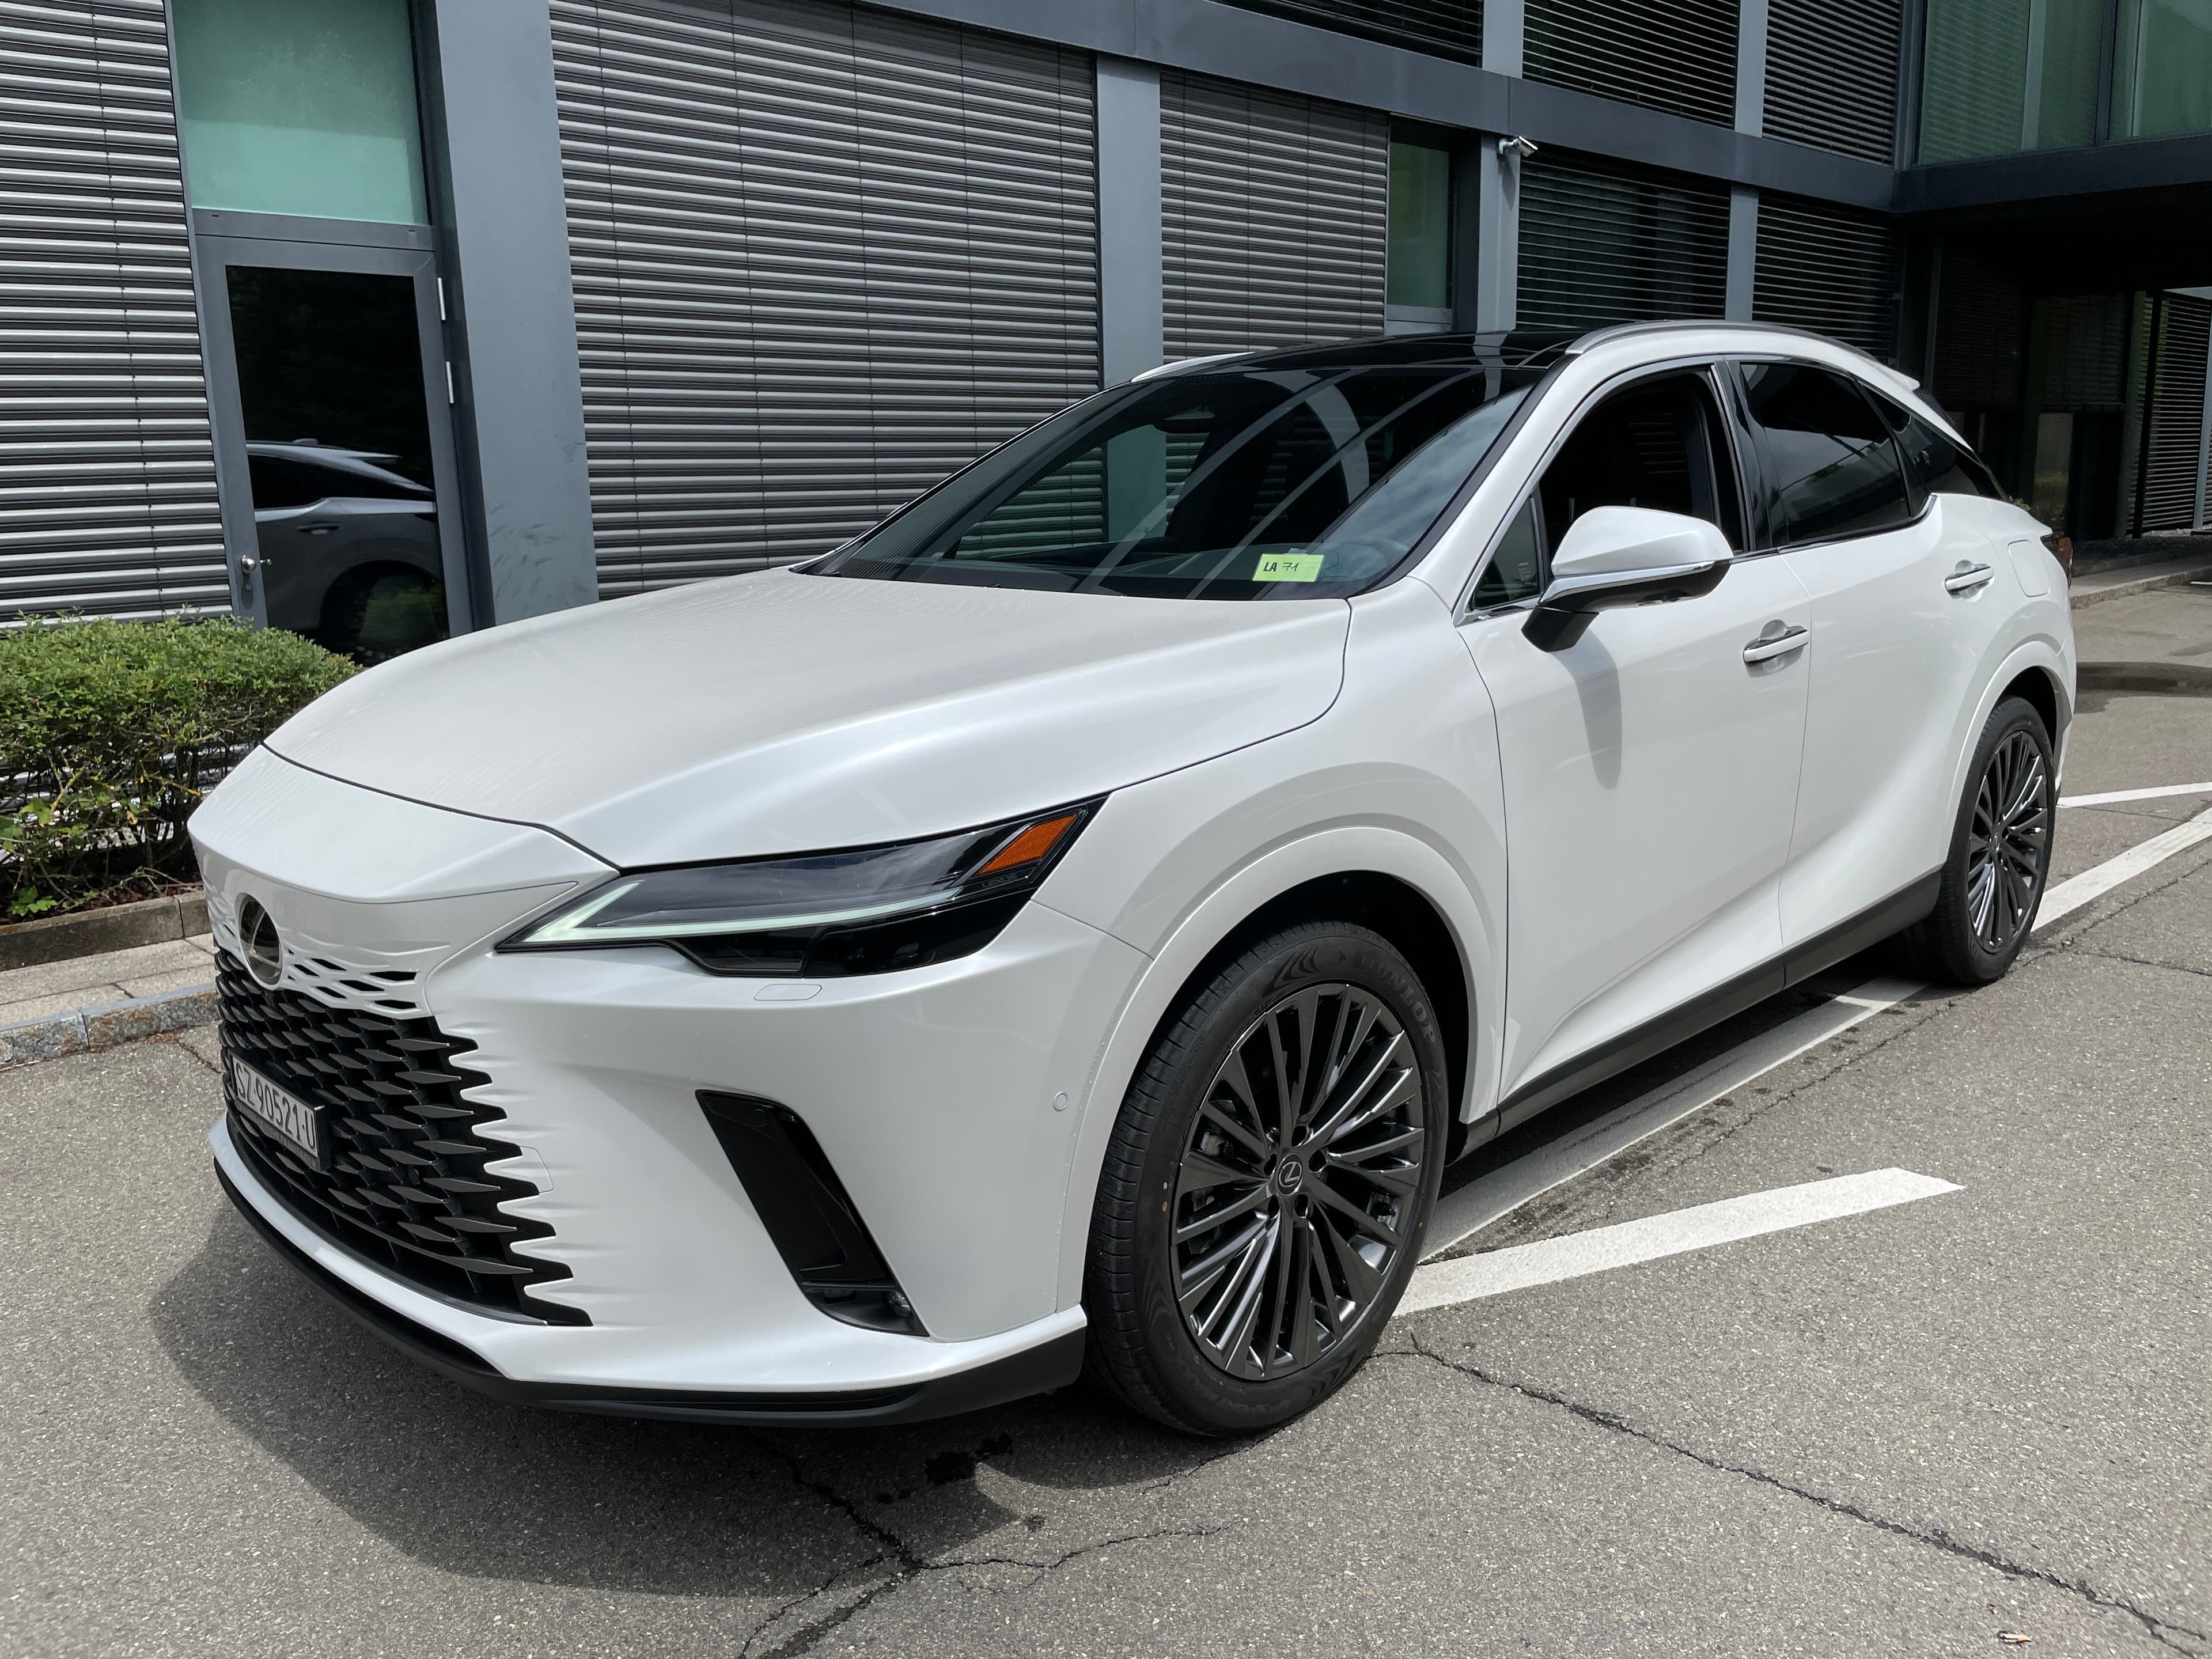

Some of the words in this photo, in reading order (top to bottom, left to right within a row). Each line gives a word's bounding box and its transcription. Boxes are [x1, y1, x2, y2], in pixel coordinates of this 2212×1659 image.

[1263, 562, 1278, 572] LA
[1282, 562, 1300, 571] 71
[982, 873, 1017, 888] LEXUS
